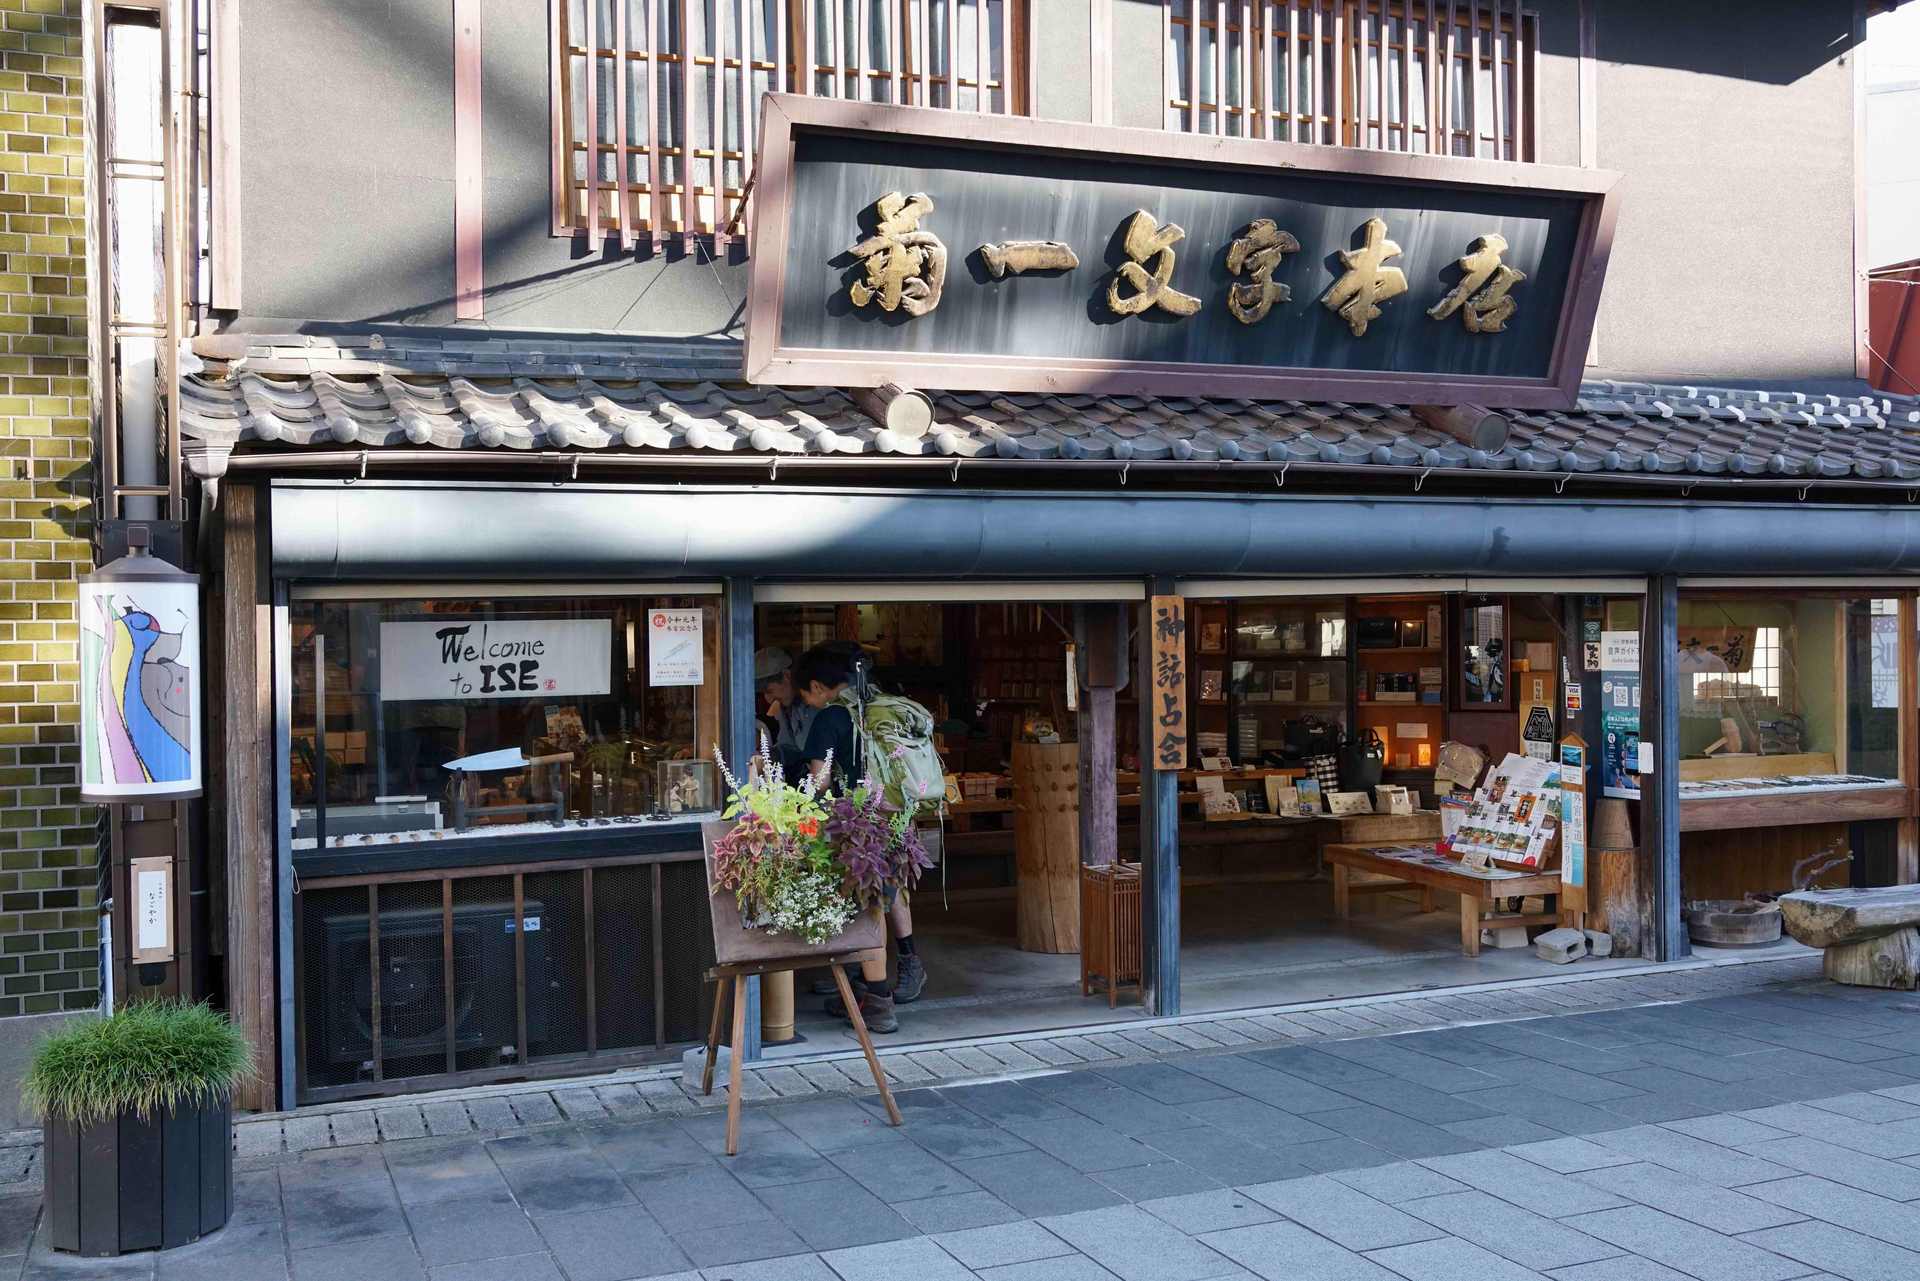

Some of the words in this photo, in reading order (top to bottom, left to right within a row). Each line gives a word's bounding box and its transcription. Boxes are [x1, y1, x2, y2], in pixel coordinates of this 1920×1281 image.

[849, 191, 1528, 337] 菊一文字本店
[667, 615, 697, 624] 令和元年
[435, 624, 545, 664] Welcome
[450, 672, 472, 697] to
[479, 660, 540, 694] ISE
[1155, 604, 1186, 765] 神話占合
